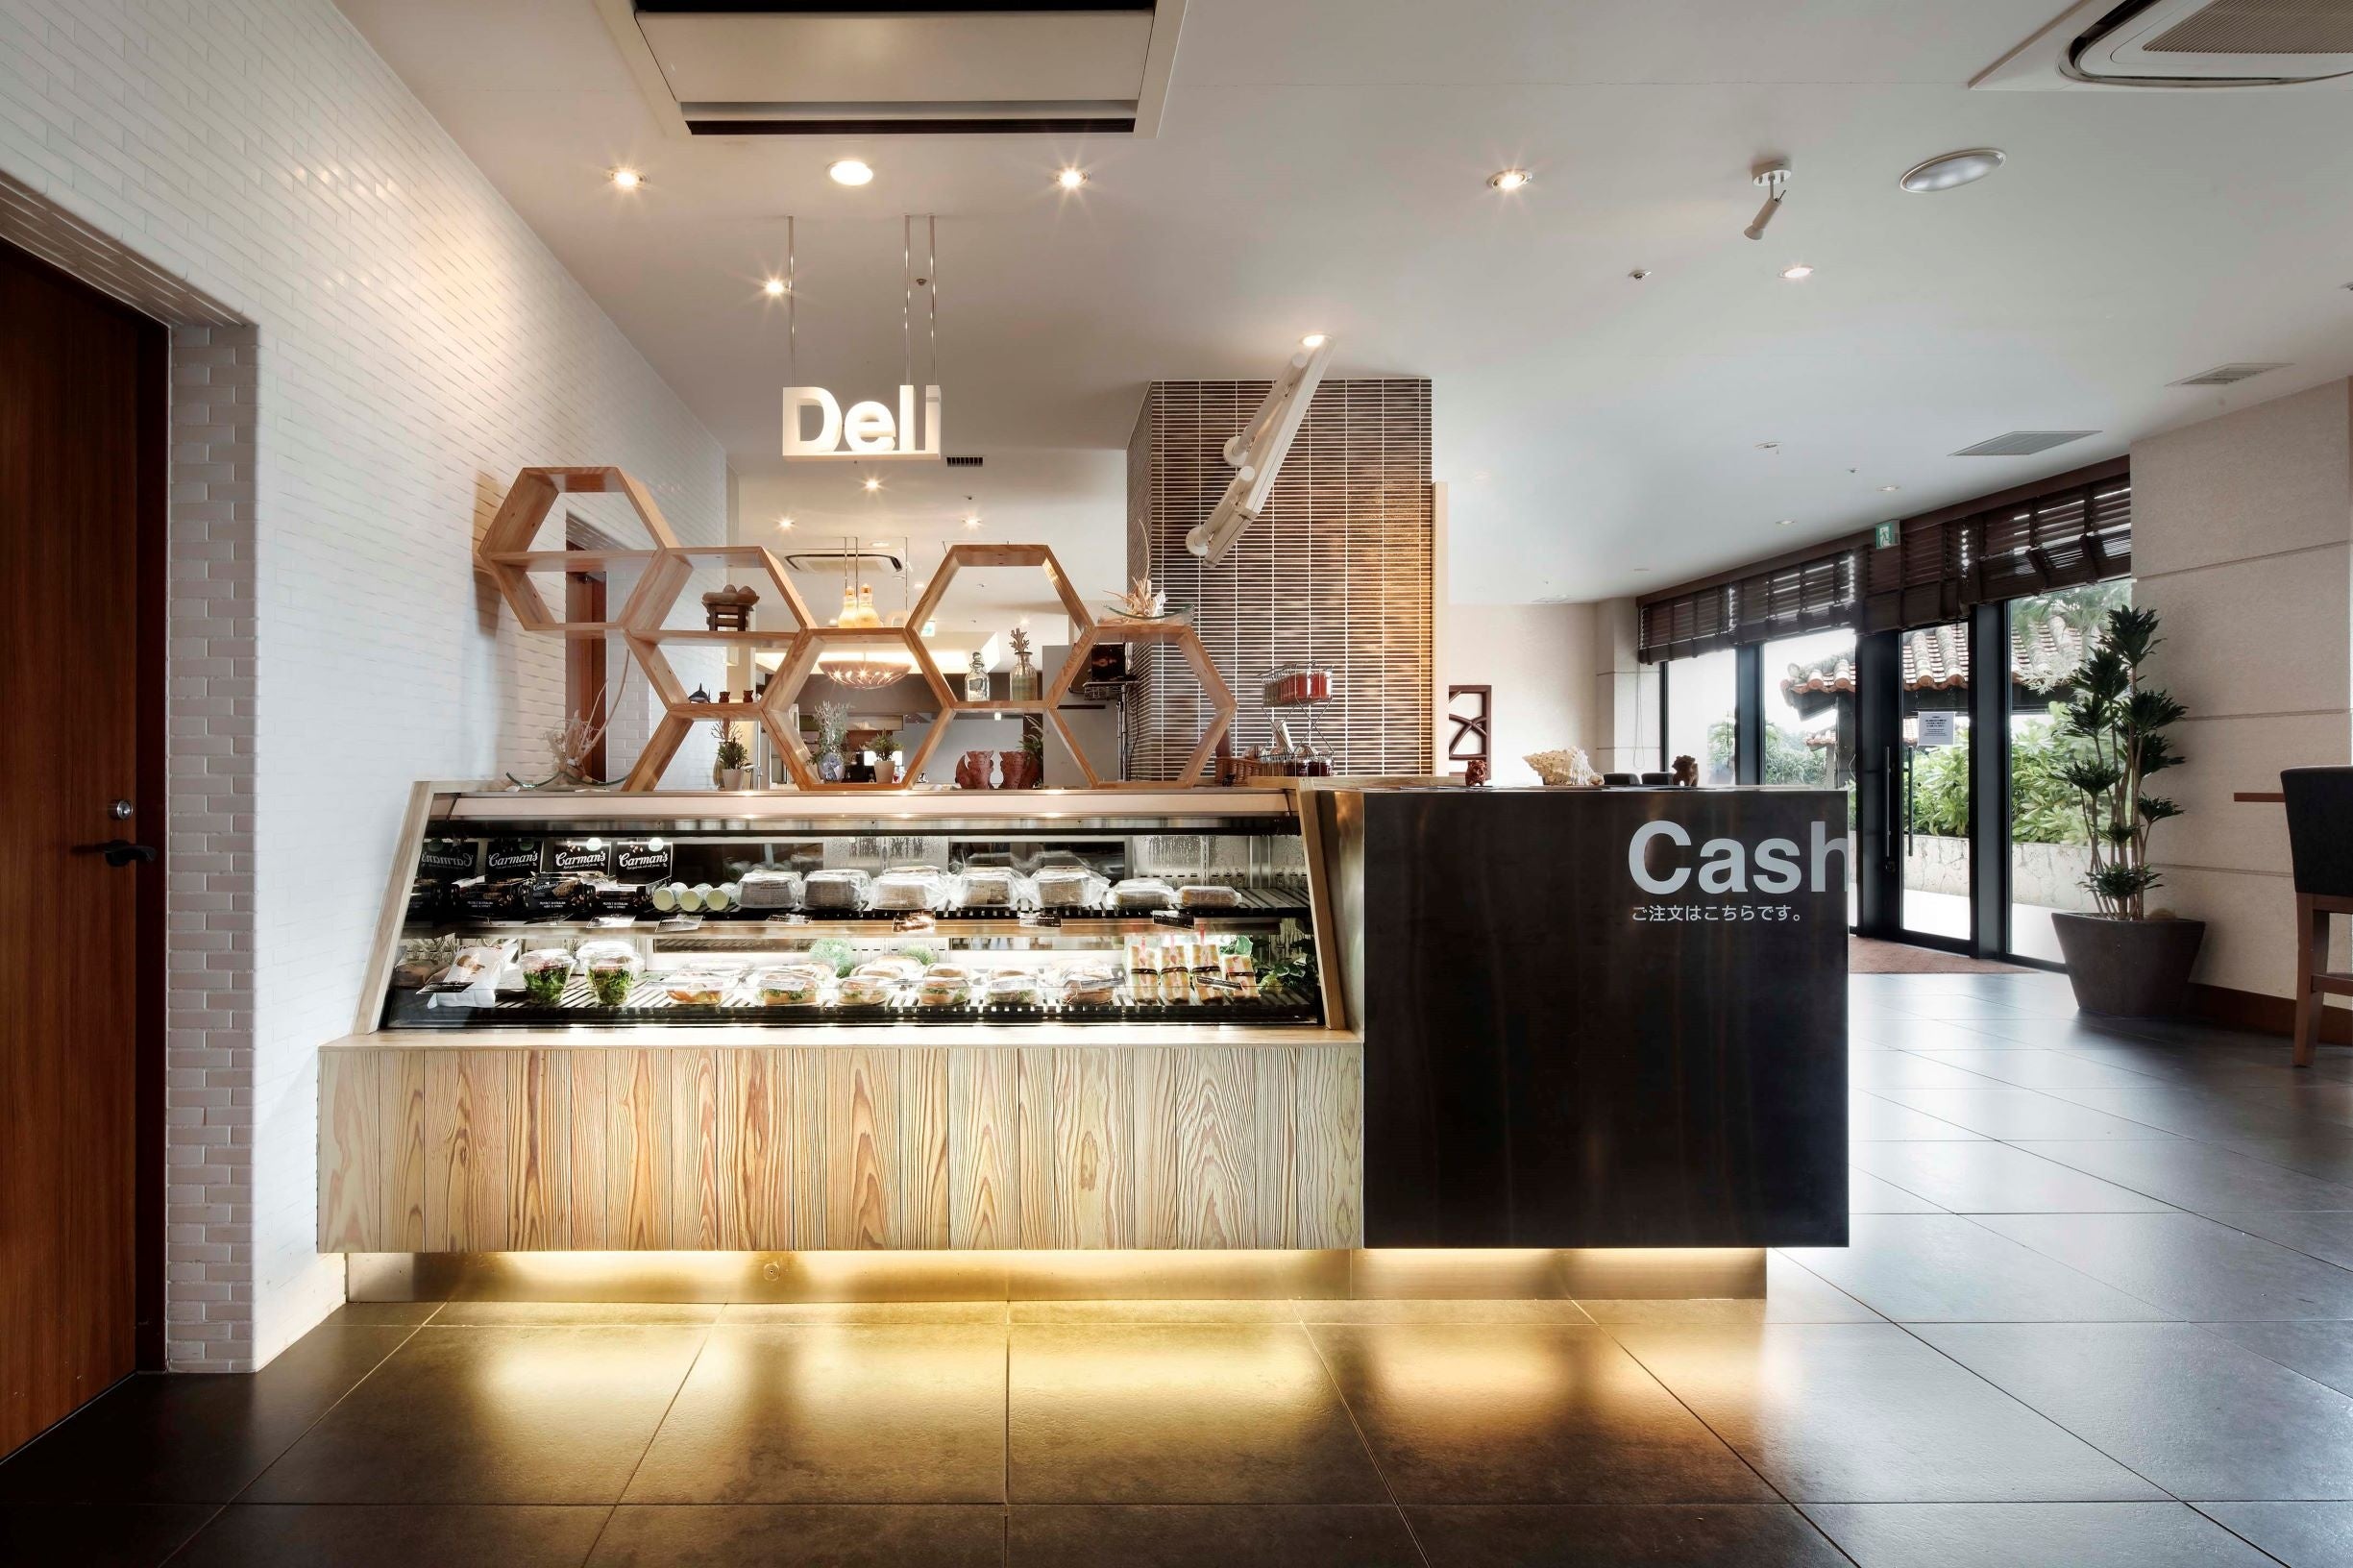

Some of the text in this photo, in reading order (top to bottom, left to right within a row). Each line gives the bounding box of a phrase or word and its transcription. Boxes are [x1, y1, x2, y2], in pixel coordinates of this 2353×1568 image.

[783, 384, 941, 457] Deli
[488, 850, 538, 867] Carman's
[555, 850, 606, 867] Carman's
[619, 851, 669, 867] Carman's
[1628, 820, 1849, 894] Cash
[1631, 904, 1802, 922] ご注文はこちらです。
